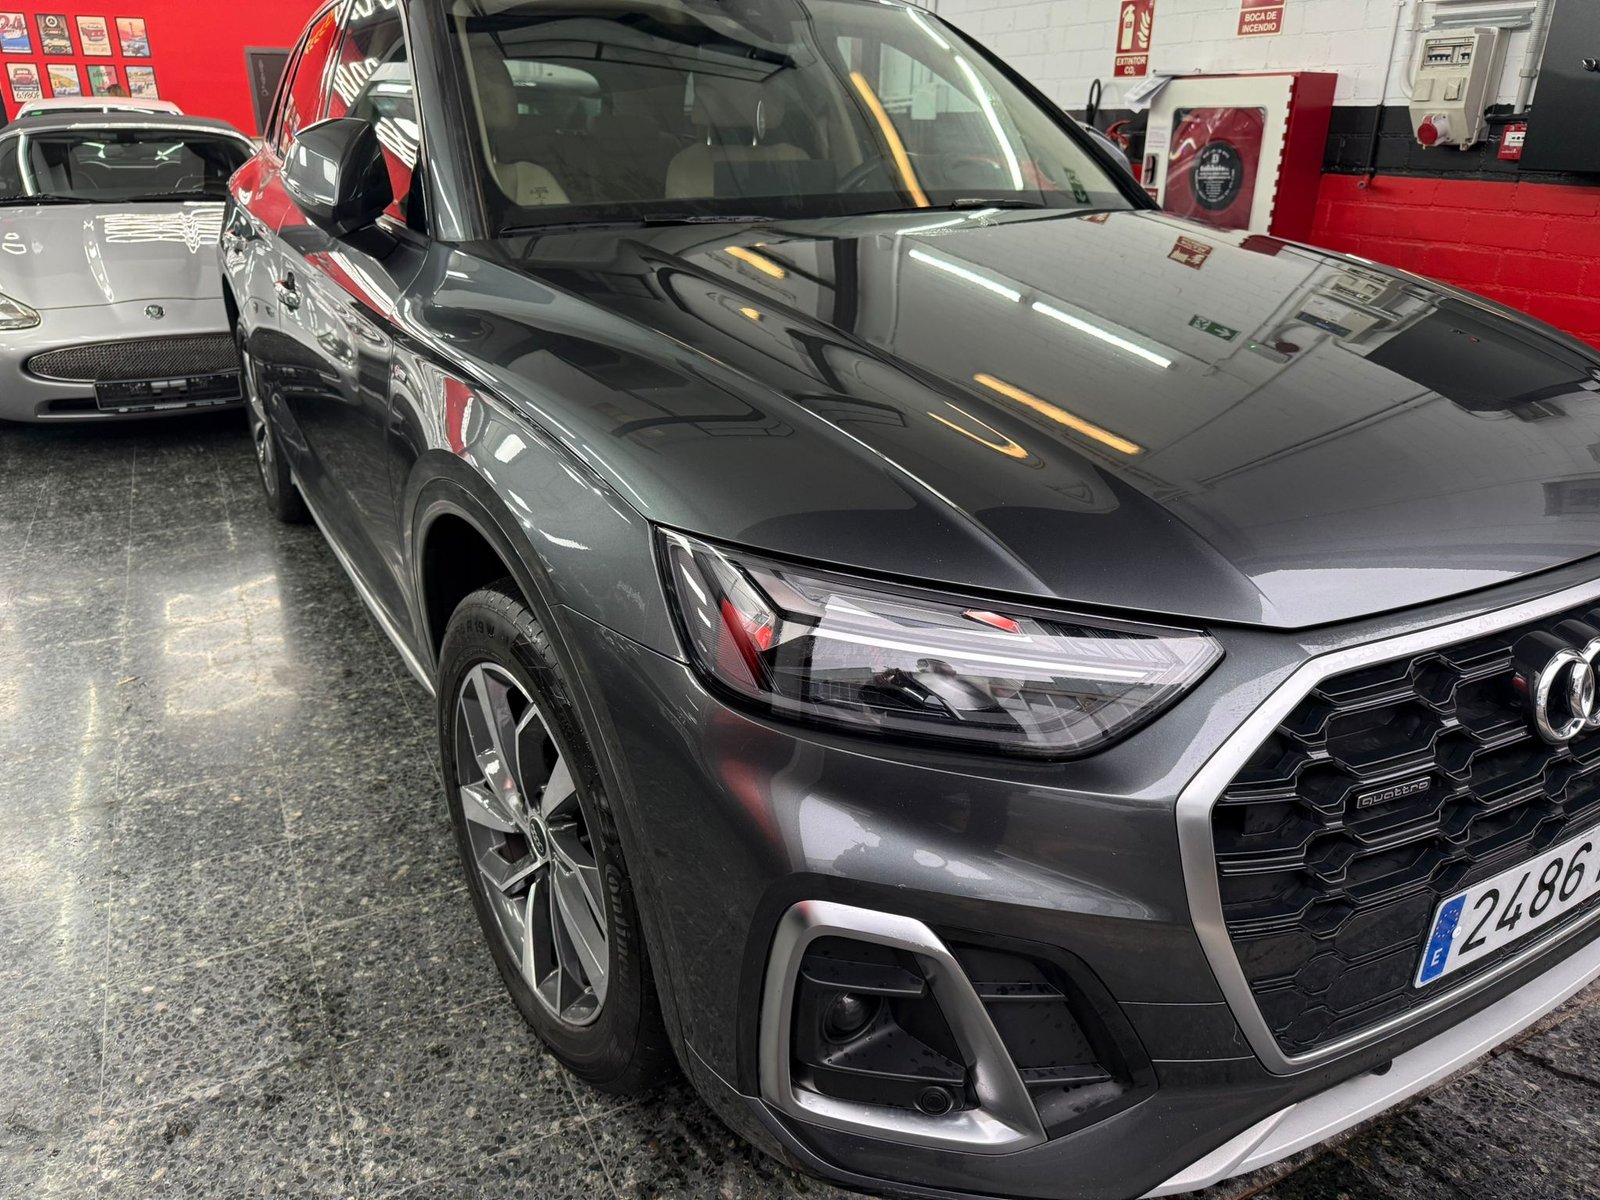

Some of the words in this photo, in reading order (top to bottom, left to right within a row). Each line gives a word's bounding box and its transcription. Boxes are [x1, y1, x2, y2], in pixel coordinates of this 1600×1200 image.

[1244, 12, 1266, 22] BOCA
[1266, 11, 1278, 20] DE
[1241, 22, 1277, 33] INCENDIO
[1116, 56, 1147, 66] EXTINTOR
[1362, 781, 1428, 806] quattro
[1458, 842, 1592, 956] 2486
[1430, 947, 1443, 967] E
